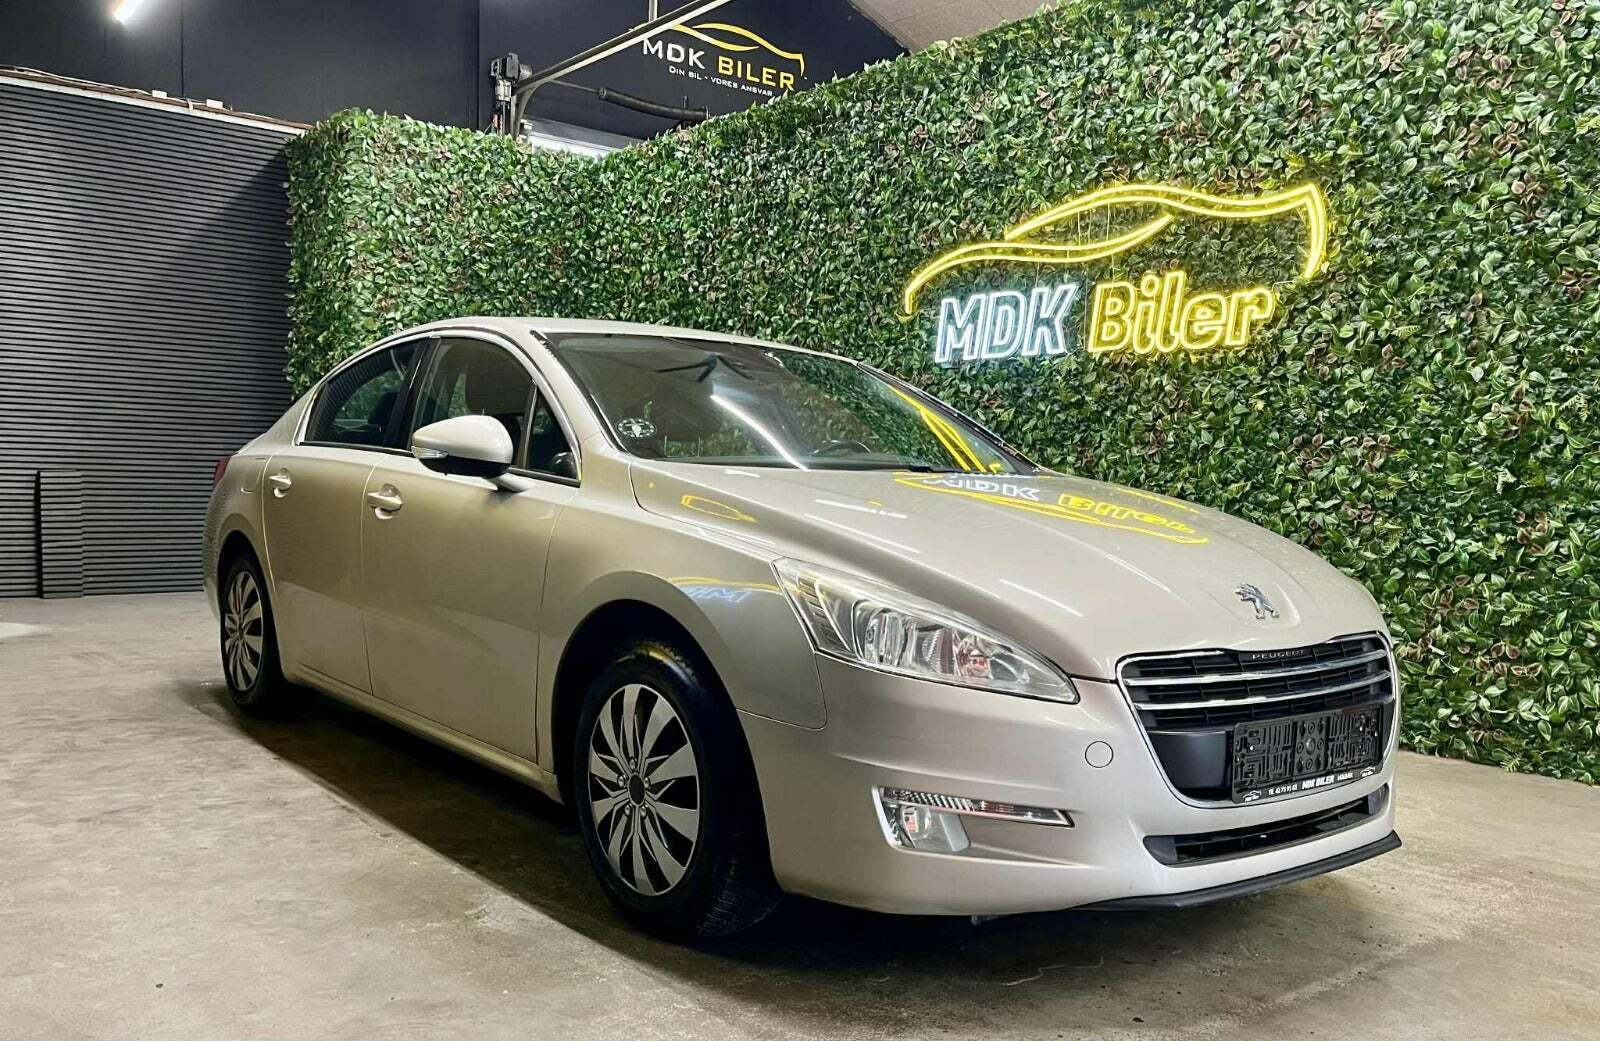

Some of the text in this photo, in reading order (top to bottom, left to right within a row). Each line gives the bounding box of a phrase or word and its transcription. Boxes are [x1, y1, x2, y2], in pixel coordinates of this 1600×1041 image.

[643, 38, 795, 91] MDK BILER
[934, 270, 1276, 363] MDK Biler
[1252, 649, 1304, 659] PEUGEOT
